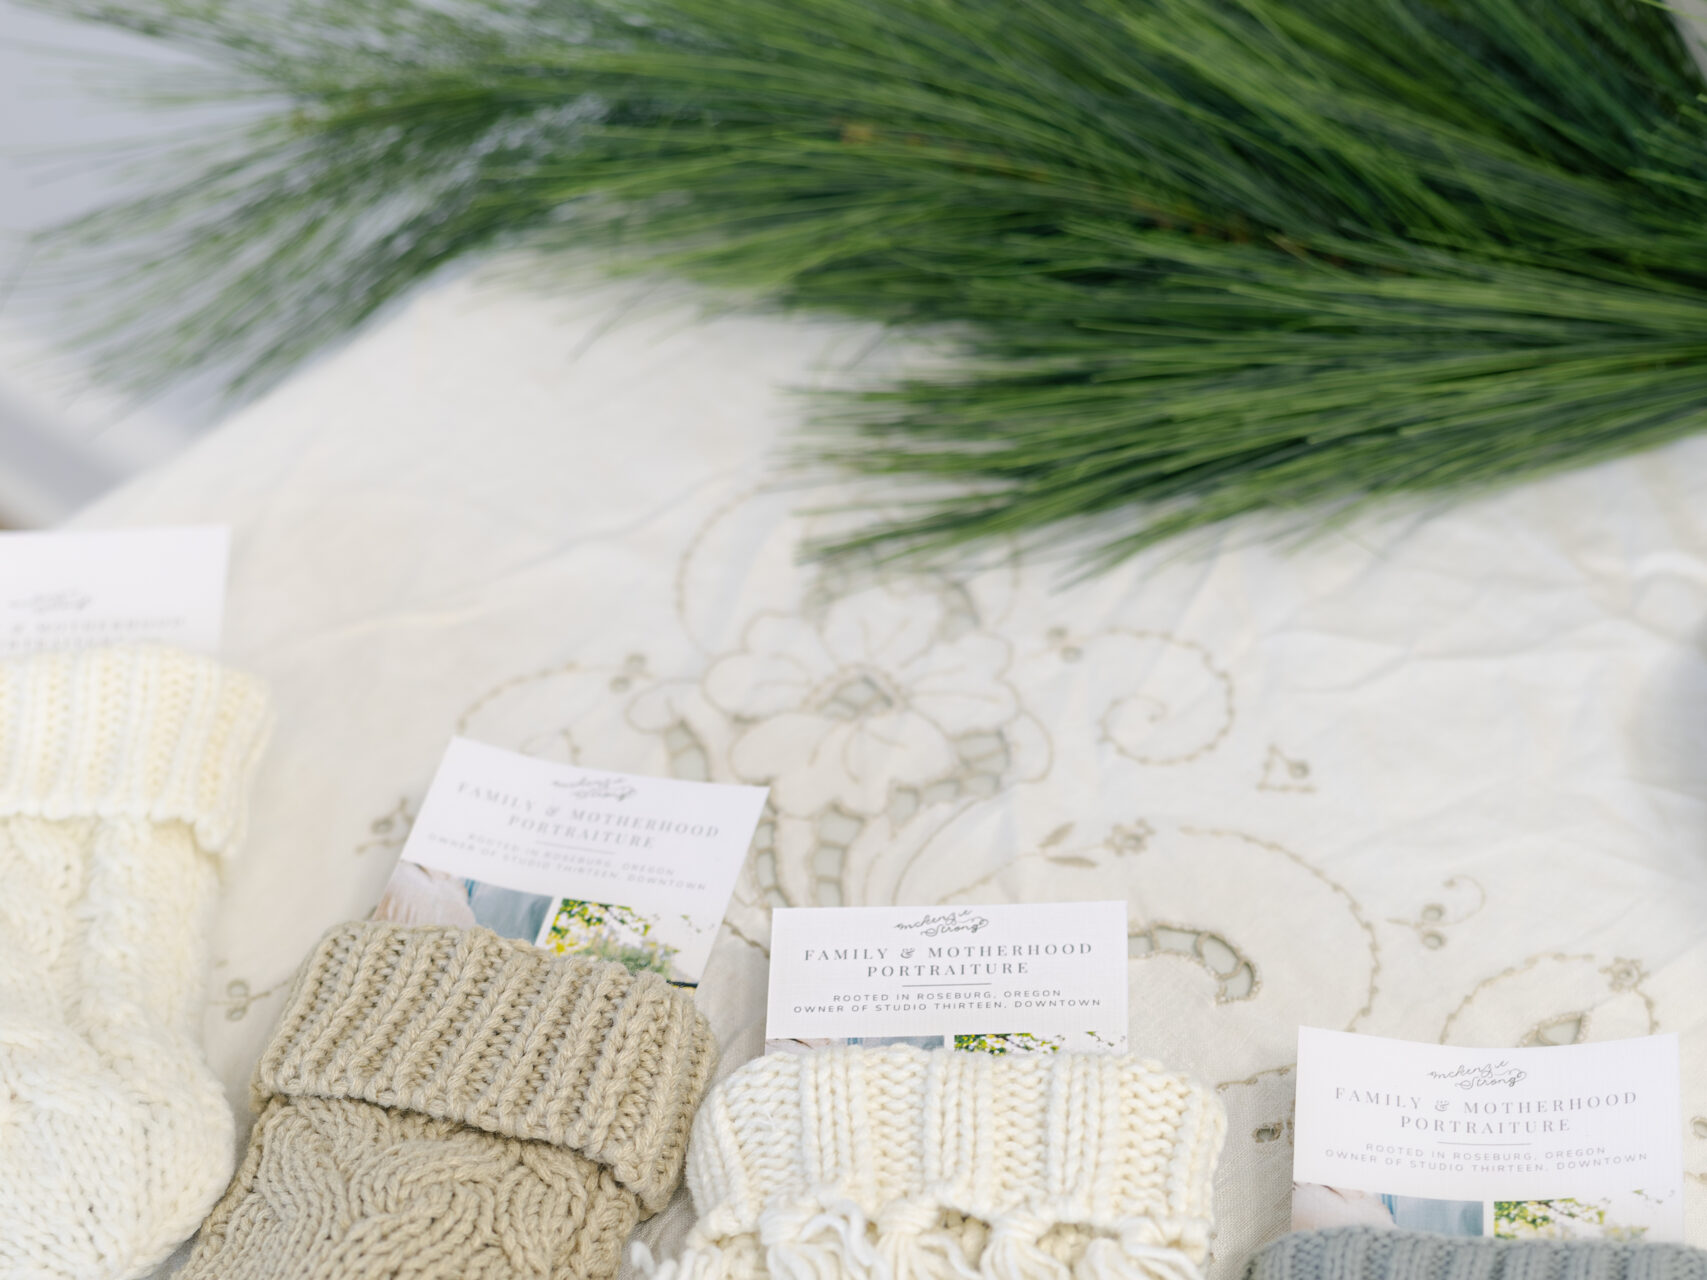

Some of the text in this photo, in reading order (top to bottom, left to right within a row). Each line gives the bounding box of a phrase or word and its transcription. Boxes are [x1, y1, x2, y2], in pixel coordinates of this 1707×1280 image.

[456, 780, 537, 813] FAMILY
[569, 808, 720, 838] MOTHERHOOD
[507, 814, 655, 849] PORTRAITURE
[804, 942, 1093, 961] FAMILY & MOTHERHOOD
[866, 962, 1029, 978] PORTRAITURE
[832, 994, 890, 1002] ROOTED
[896, 992, 910, 1001] IN
[1003, 989, 1062, 999] OREGON
[793, 1004, 845, 1014] OWNER
[851, 1003, 868, 1012] OF
[874, 1002, 928, 1012] STUDIO
[1014, 998, 1102, 1008] DOWNTOWN
[1335, 1087, 1637, 1114] FAMILY & MOTHERHOOD
[1400, 1115, 1570, 1134] PORTRAITURE
[1325, 1148, 1378, 1163] OWNER
[1384, 1157, 1402, 1166] OF
[1409, 1159, 1464, 1172] STUDIO
[1557, 1152, 1648, 1170] DOWNTOWN
[1365, 1143, 1424, 1158] ROOTED
[1431, 1151, 1446, 1159] IN
[1544, 1146, 1606, 1159] OREGON
